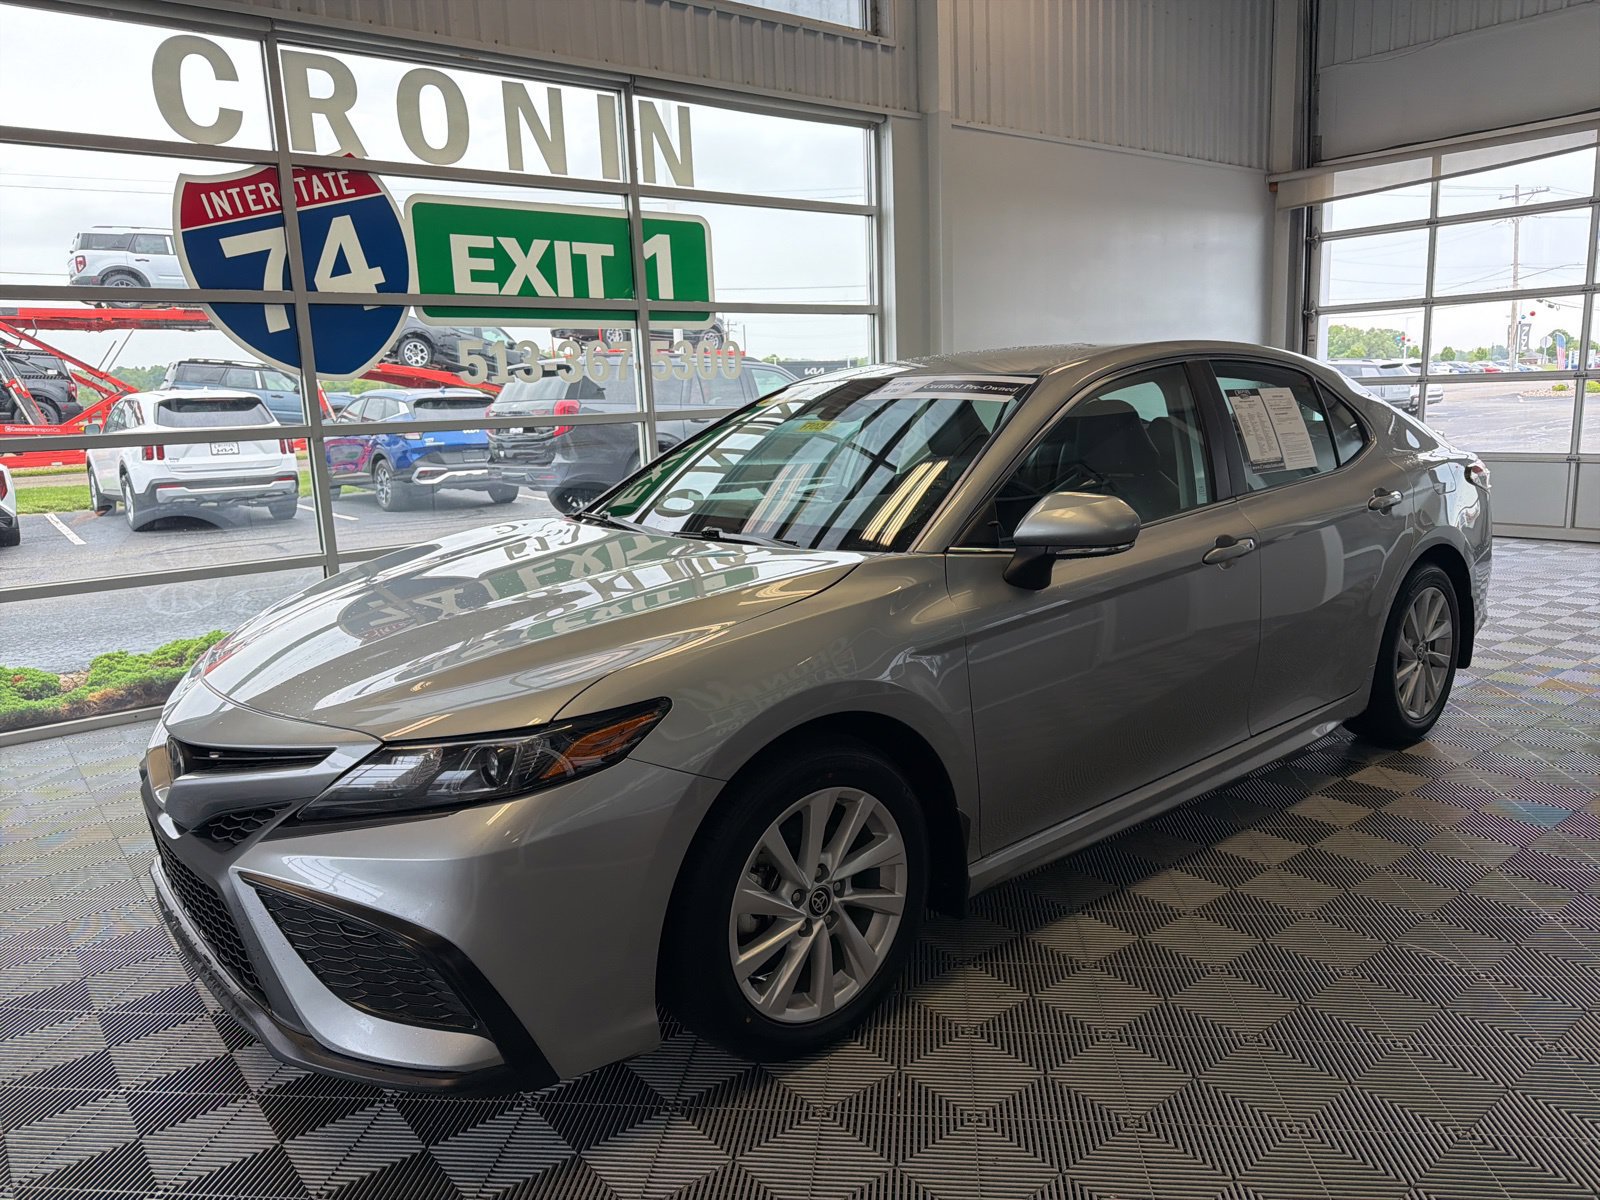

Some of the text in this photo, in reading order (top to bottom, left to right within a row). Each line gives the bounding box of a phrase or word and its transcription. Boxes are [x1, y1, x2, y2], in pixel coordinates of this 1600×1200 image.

[152, 34, 694, 187] CRONIN
[200, 170, 356, 220] INTERTATE
[218, 214, 387, 334] 74
[449, 234, 674, 300] EXIT 1
[456, 339, 742, 385] 513-3675300
[964, 384, 1019, 392] Pre-Owned
